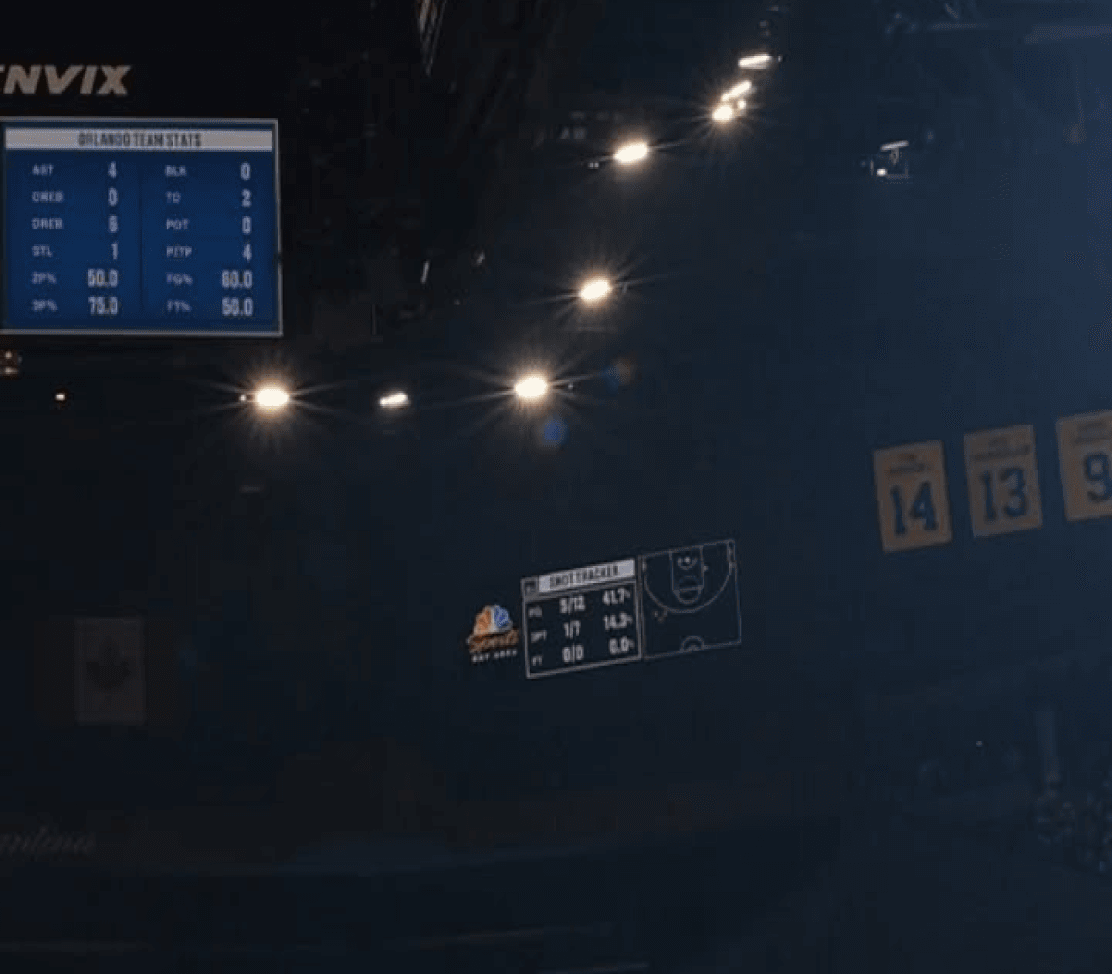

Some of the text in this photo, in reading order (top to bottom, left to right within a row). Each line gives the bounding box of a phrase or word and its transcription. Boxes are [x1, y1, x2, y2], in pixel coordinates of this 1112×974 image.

[133, 132, 162, 146] TEAM
[165, 132, 201, 146] STATS
[107, 161, 117, 178] 4
[240, 162, 251, 180] 0
[108, 187, 118, 206] 0
[241, 189, 251, 207] 2
[242, 216, 251, 234] 0
[111, 243, 118, 260] 1
[242, 244, 252, 262] 4
[1084, 452, 1112, 503] 9
[979, 467, 1028, 523] 13
[889, 480, 939, 536] 14
